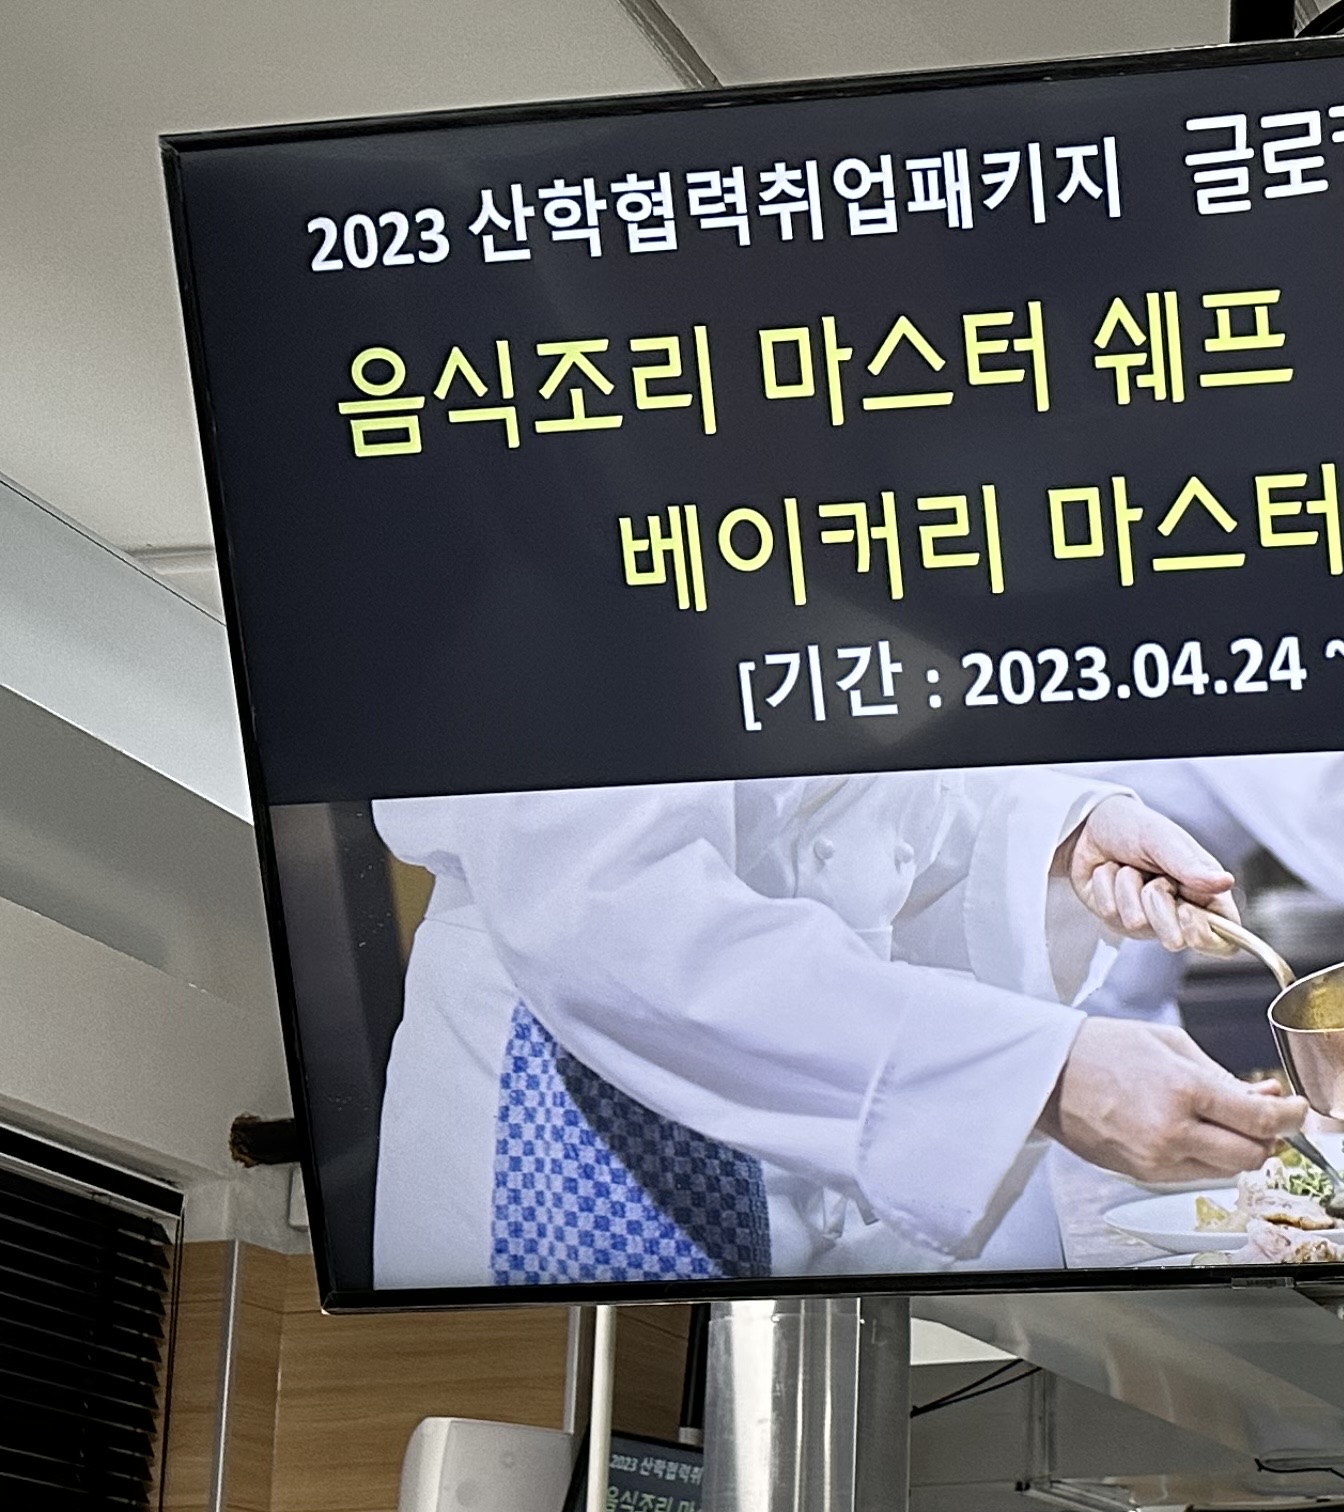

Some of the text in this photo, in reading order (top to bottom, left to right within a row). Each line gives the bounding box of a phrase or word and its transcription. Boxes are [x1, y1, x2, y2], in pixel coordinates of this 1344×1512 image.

[307, 208, 450, 272] 2023
[468, 136, 1121, 263] 산학협력취업패키지
[338, 325, 717, 458] 음식조리
[758, 300, 1050, 426] 마스터
[1093, 289, 1294, 405] 쉐프
[618, 484, 1005, 612] 베이커리
[1047, 463, 1344, 587] 마스터
[738, 640, 903, 732] [기간
[961, 636, 1308, 706] 2023.04.24
